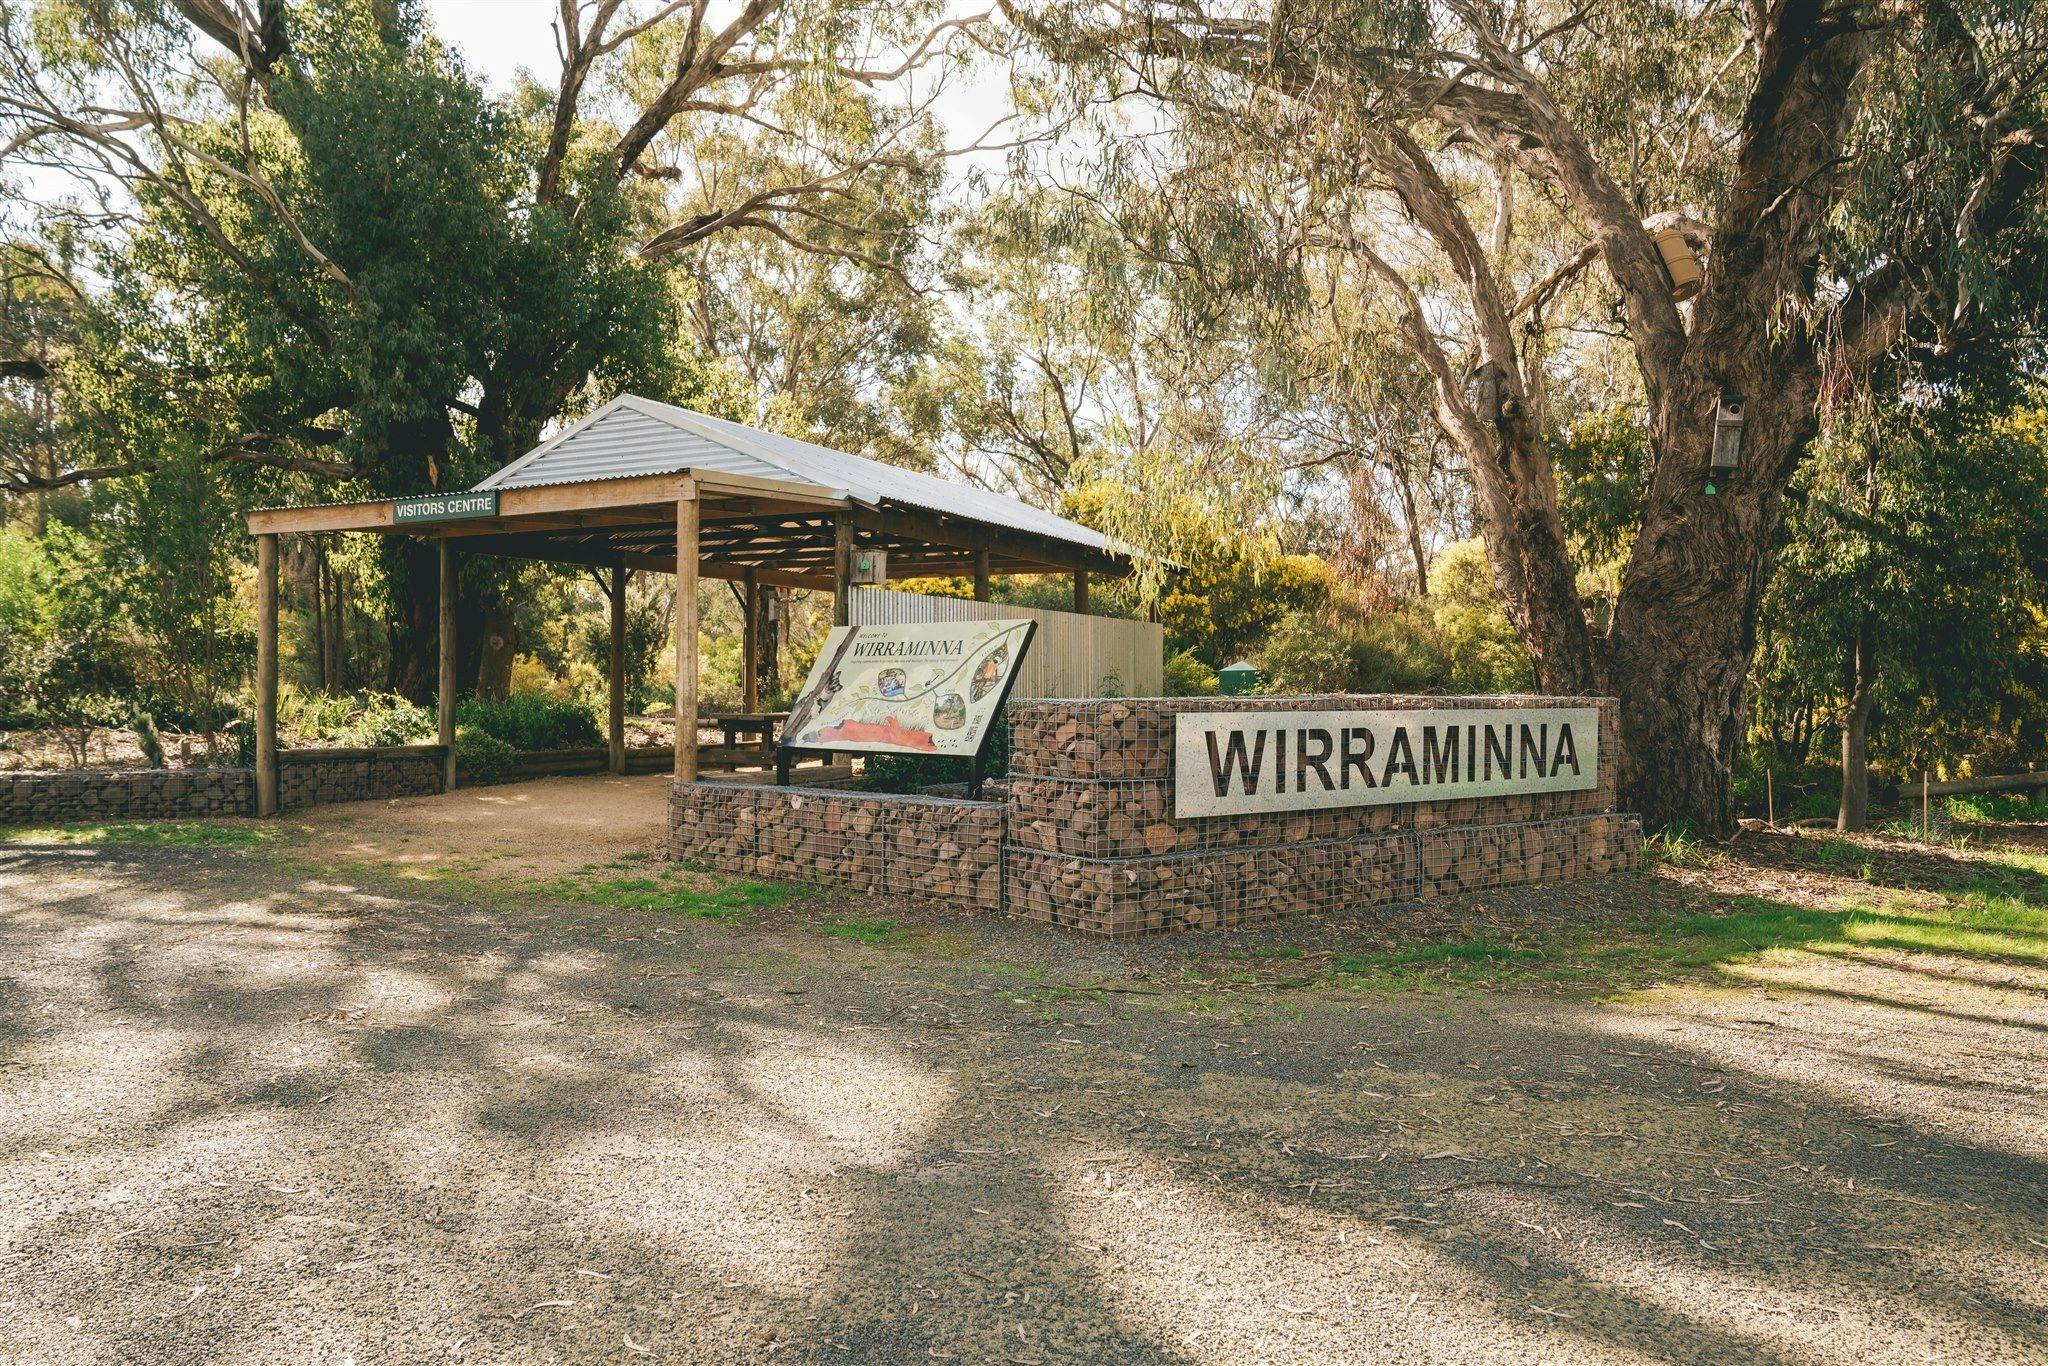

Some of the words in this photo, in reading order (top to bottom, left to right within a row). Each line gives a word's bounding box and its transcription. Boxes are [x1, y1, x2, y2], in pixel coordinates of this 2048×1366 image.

[396, 502, 445, 518] VISITORS
[447, 497, 492, 514] CENTRE
[853, 640, 964, 657] WIRRAMINNA
[1204, 723, 1581, 797] WIRRAMINNA
